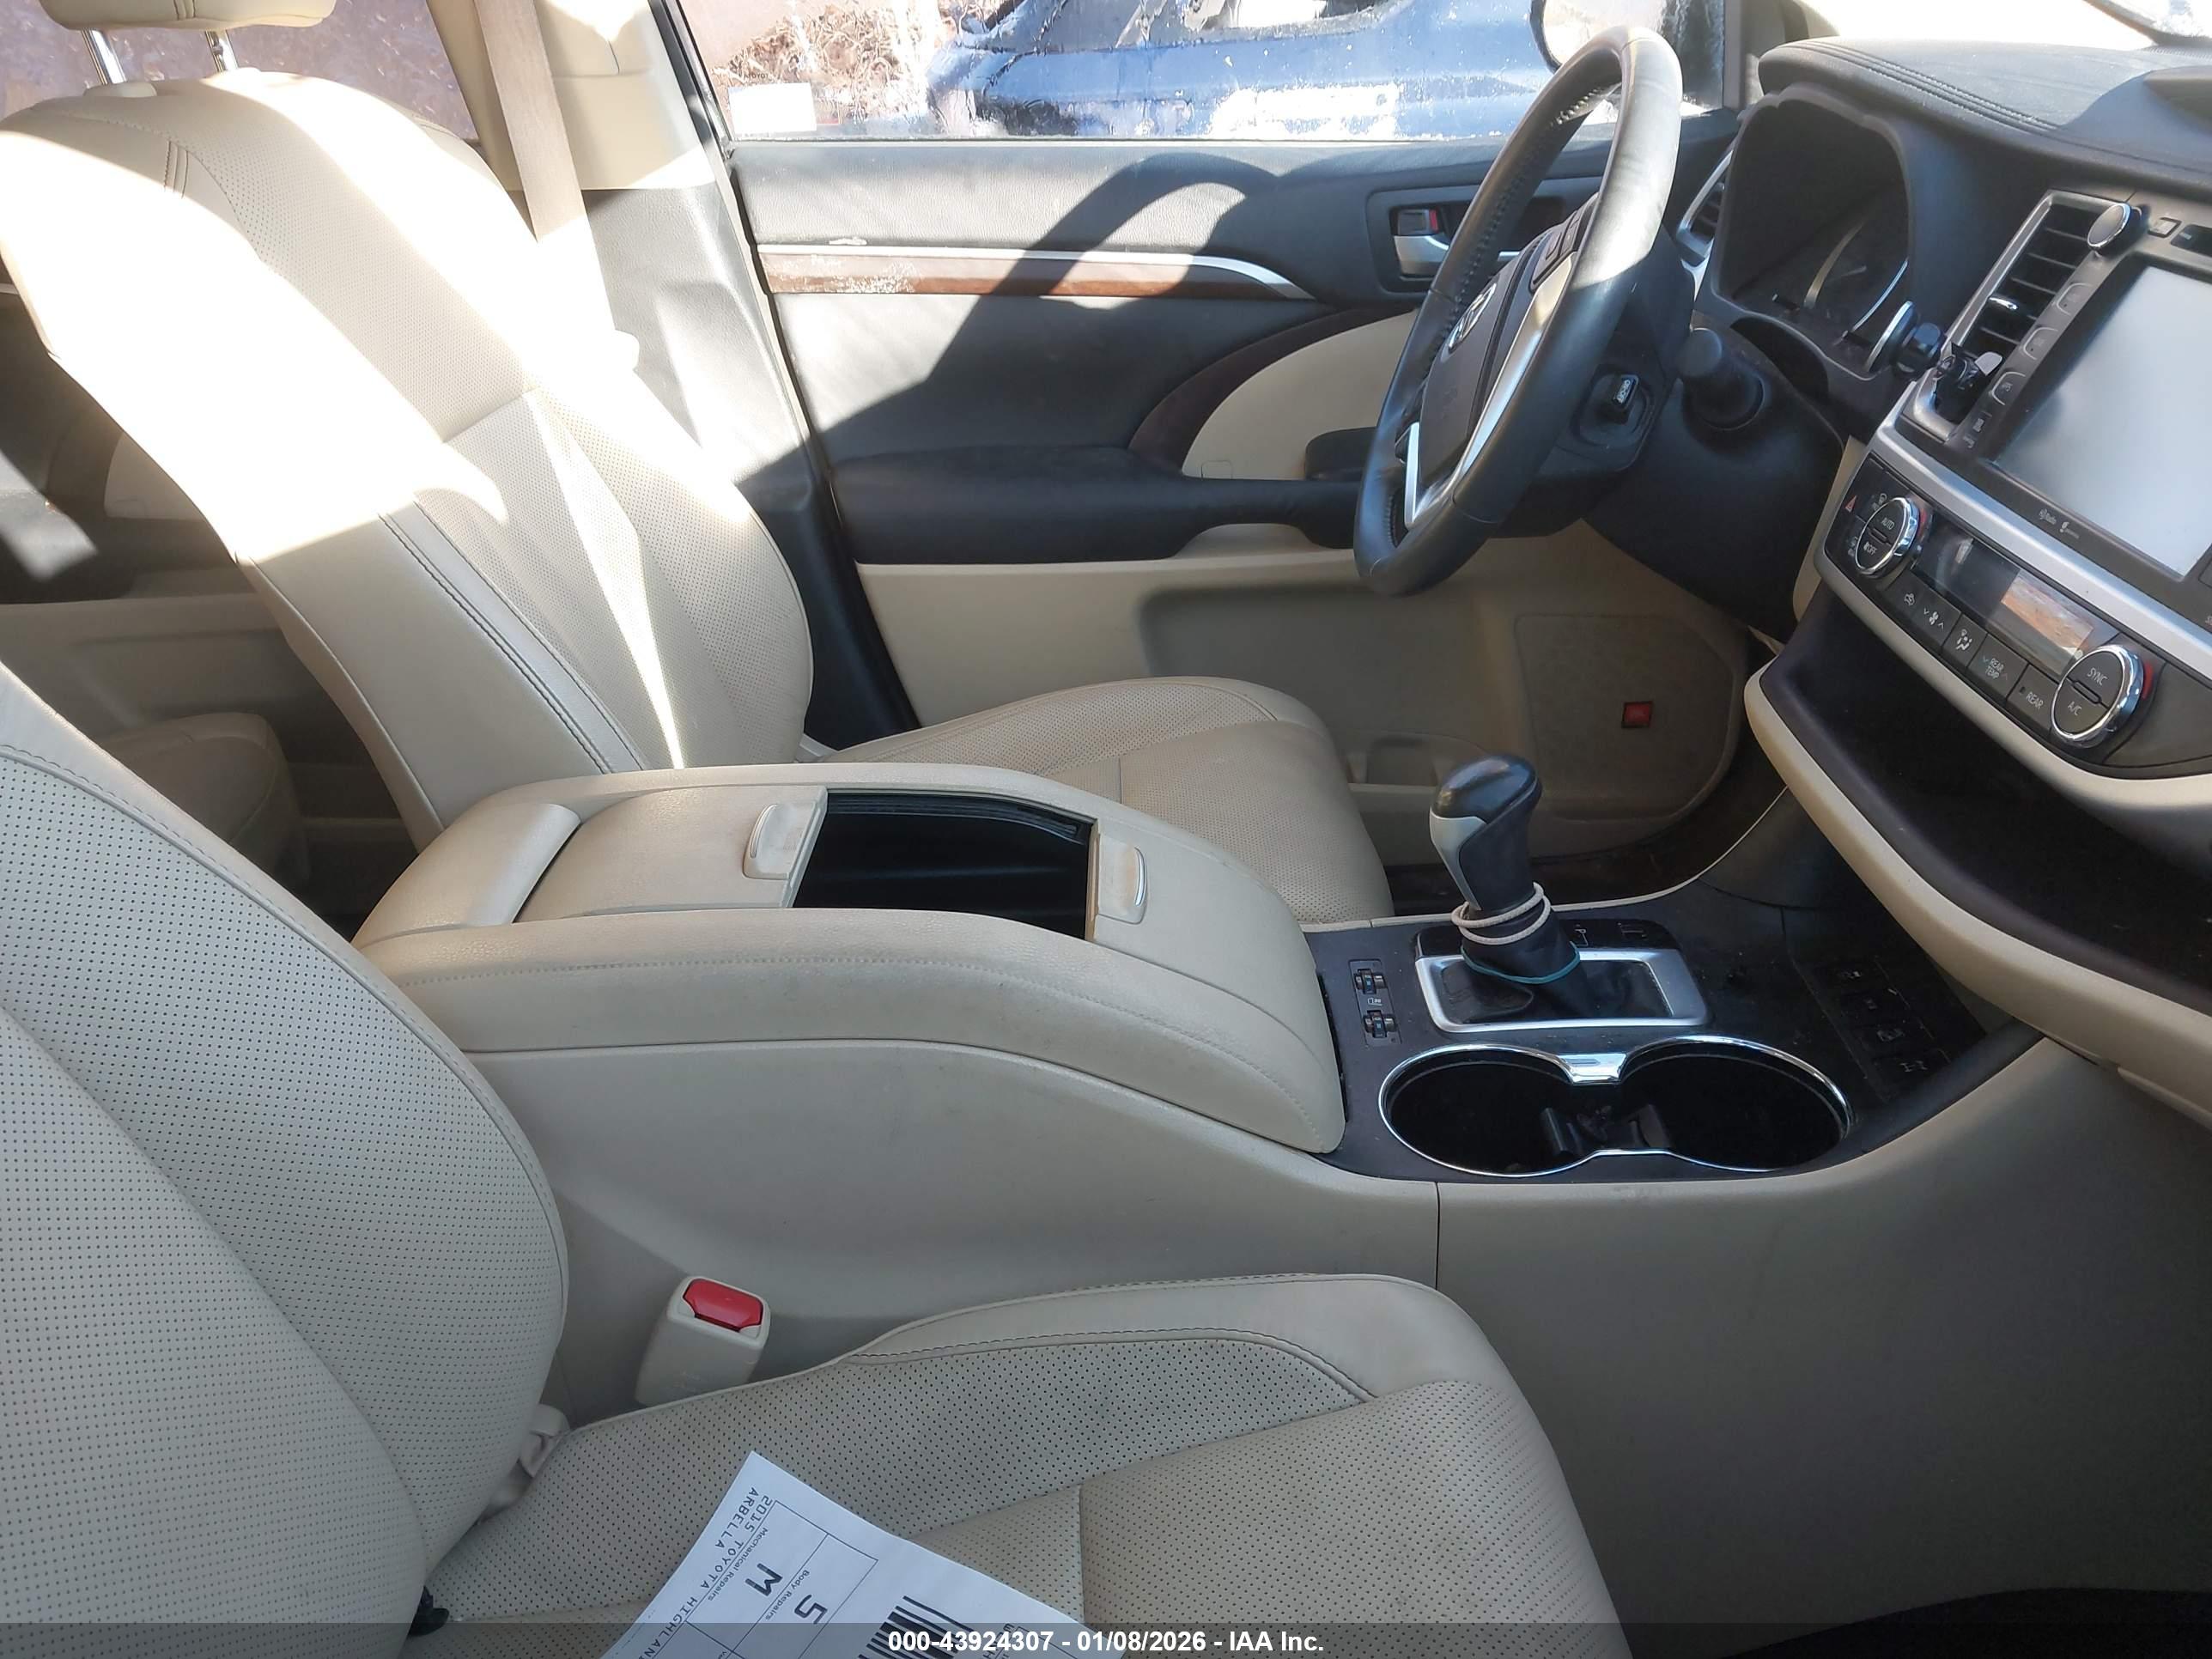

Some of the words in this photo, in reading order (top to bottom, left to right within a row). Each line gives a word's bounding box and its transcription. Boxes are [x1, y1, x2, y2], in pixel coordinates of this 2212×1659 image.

[1881, 517, 1895, 530] AUTO
[1984, 665, 2000, 680] TEMP
[1990, 657, 2004, 673] REAR
[2086, 666, 2108, 686] SYNC
[2025, 690, 2045, 711] REAR
[2067, 701, 2083, 716] A/C
[714, 1486, 760, 1548] ARBELLA
[744, 1495, 772, 1533] 2015
[733, 1526, 769, 1572] Mechanical
[701, 1540, 744, 1589] TOYOTA
[790, 1569, 810, 1589] Body
[708, 1571, 735, 1601] Repairs
[744, 1563, 783, 1597] M
[765, 1590, 792, 1620] Repairs
[793, 1594, 828, 1625] 5
